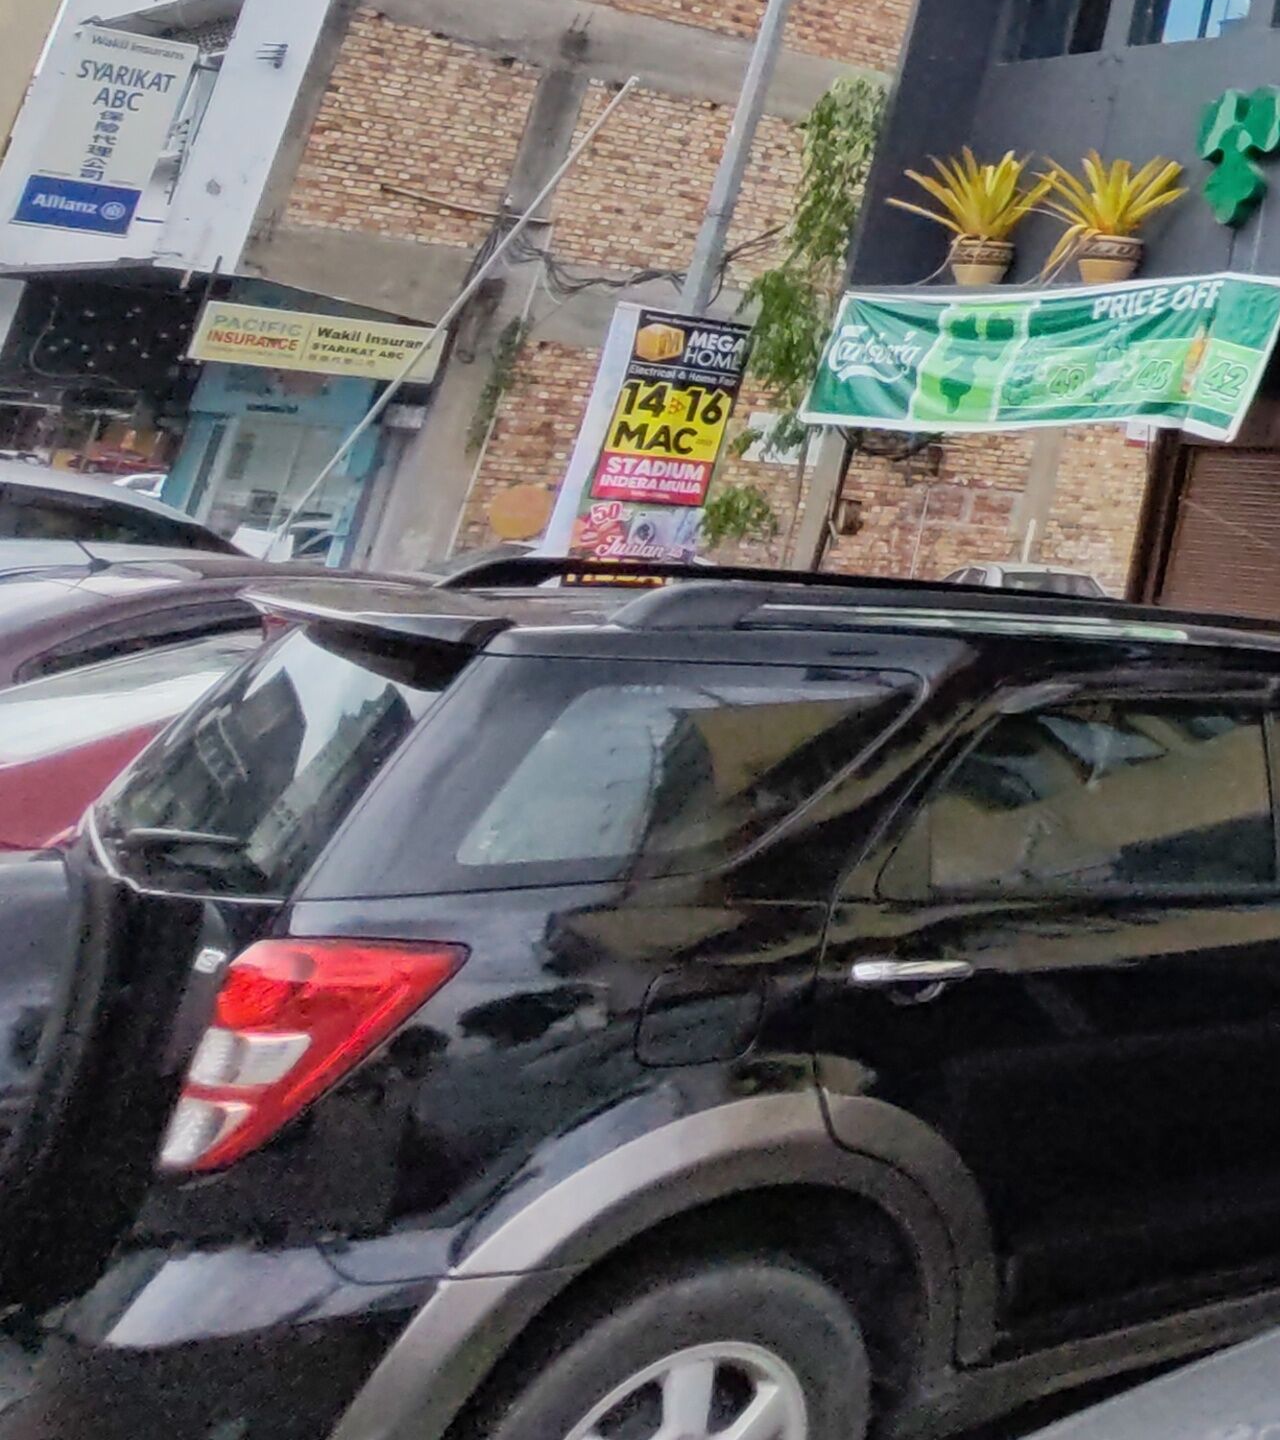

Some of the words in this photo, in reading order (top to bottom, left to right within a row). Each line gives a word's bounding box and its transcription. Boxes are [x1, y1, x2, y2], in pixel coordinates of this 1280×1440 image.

[76, 59, 176, 94] SYARIKAT
[92, 87, 145, 112] ABC
[32, 193, 97, 214] Allianz
[1092, 288, 1168, 321] PRICE
[1170, 279, 1225, 312] OFF
[211, 313, 303, 338] PACIFIC
[317, 325, 362, 344] Wakil
[206, 329, 301, 352] INSURANCE
[686, 329, 746, 353] MEGA
[1204, 361, 1249, 399] 42
[622, 381, 669, 418] 14
[684, 389, 723, 425] 16
[612, 421, 698, 455] MAC
[606, 456, 705, 482] STADIUM
[600, 475, 658, 491] INDERA
[658, 480, 700, 494] MULIA
